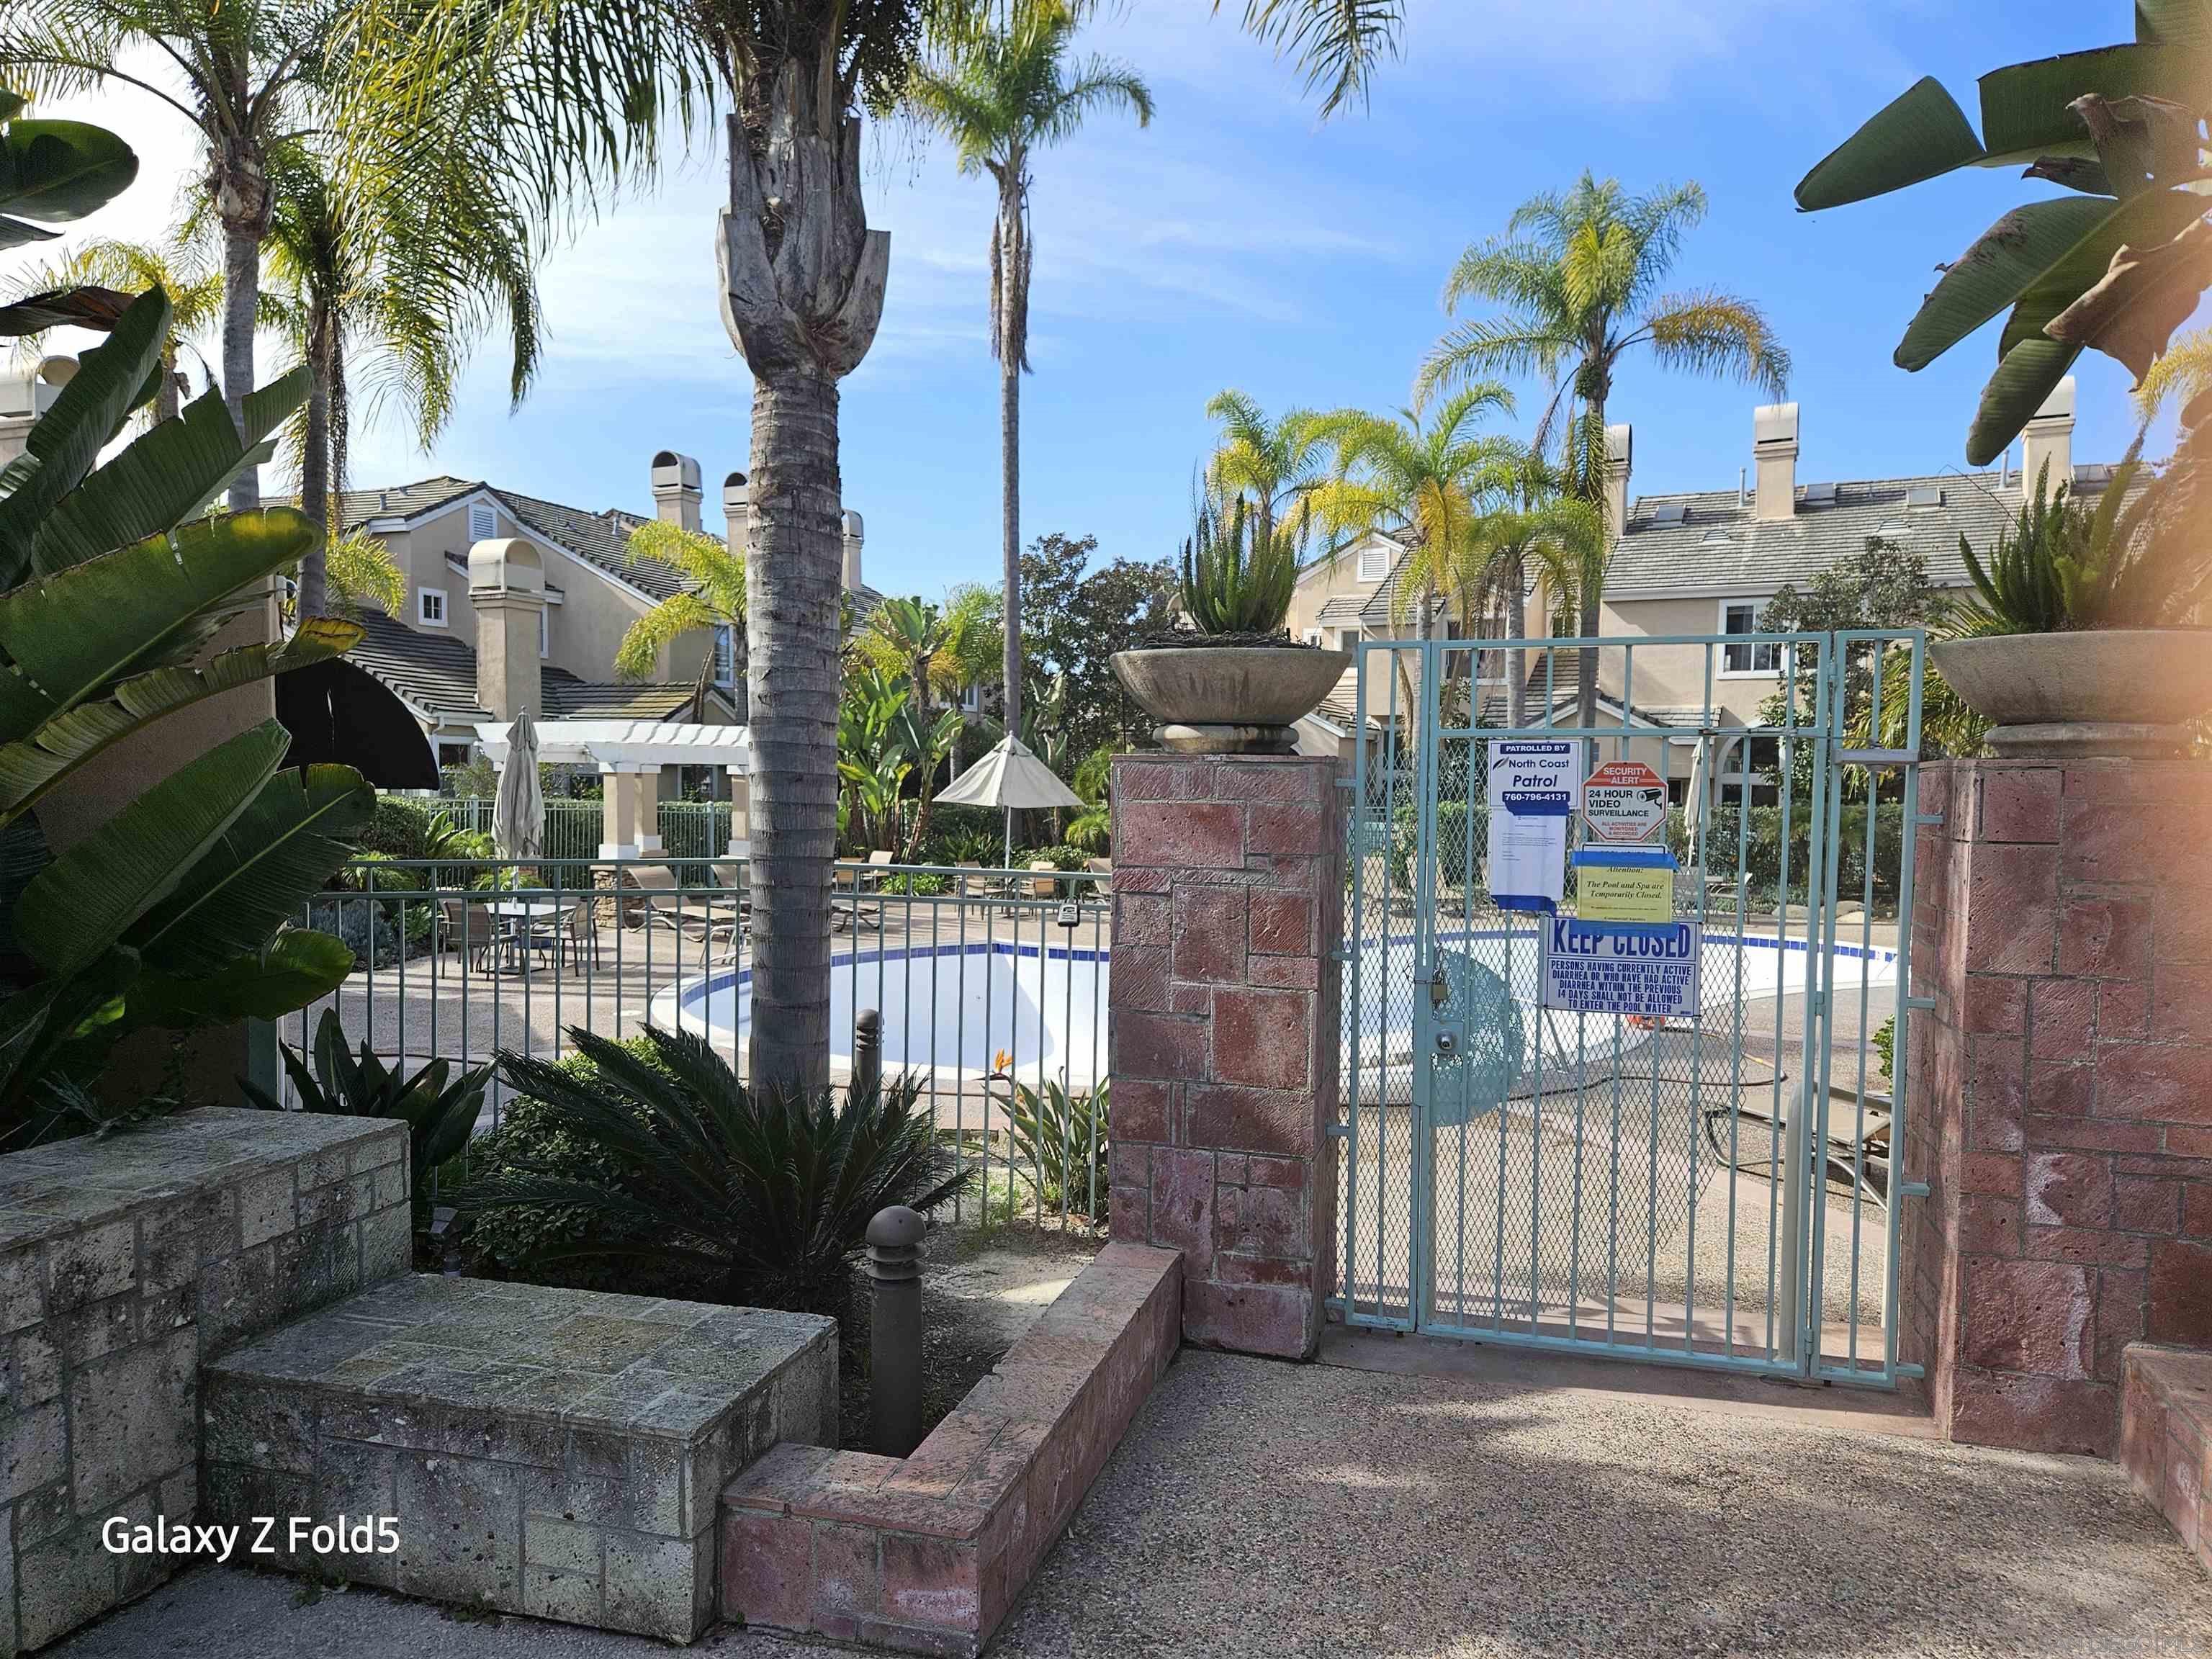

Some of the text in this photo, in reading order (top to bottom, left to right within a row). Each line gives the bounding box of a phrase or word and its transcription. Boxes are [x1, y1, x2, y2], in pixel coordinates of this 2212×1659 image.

[1509, 759, 1569, 768] North Coast
[1603, 767, 1647, 775] SECURITY
[1513, 774, 1557, 787] Patrol
[1551, 961, 1691, 976] PERSONS HAVING CURRENTLY ACTIVE
[1552, 970, 1689, 985] DIARRHEA OR WHO HAVE HAD ACTIVE
[1560, 980, 1681, 994] DIARRHEA WITHIN THE PREVIOUS
[1557, 989, 1682, 1004] 14 DAYS SHALL NOT BE ALLOWED
[1568, 999, 1671, 1013] TO ENTER THE POOL WATER
